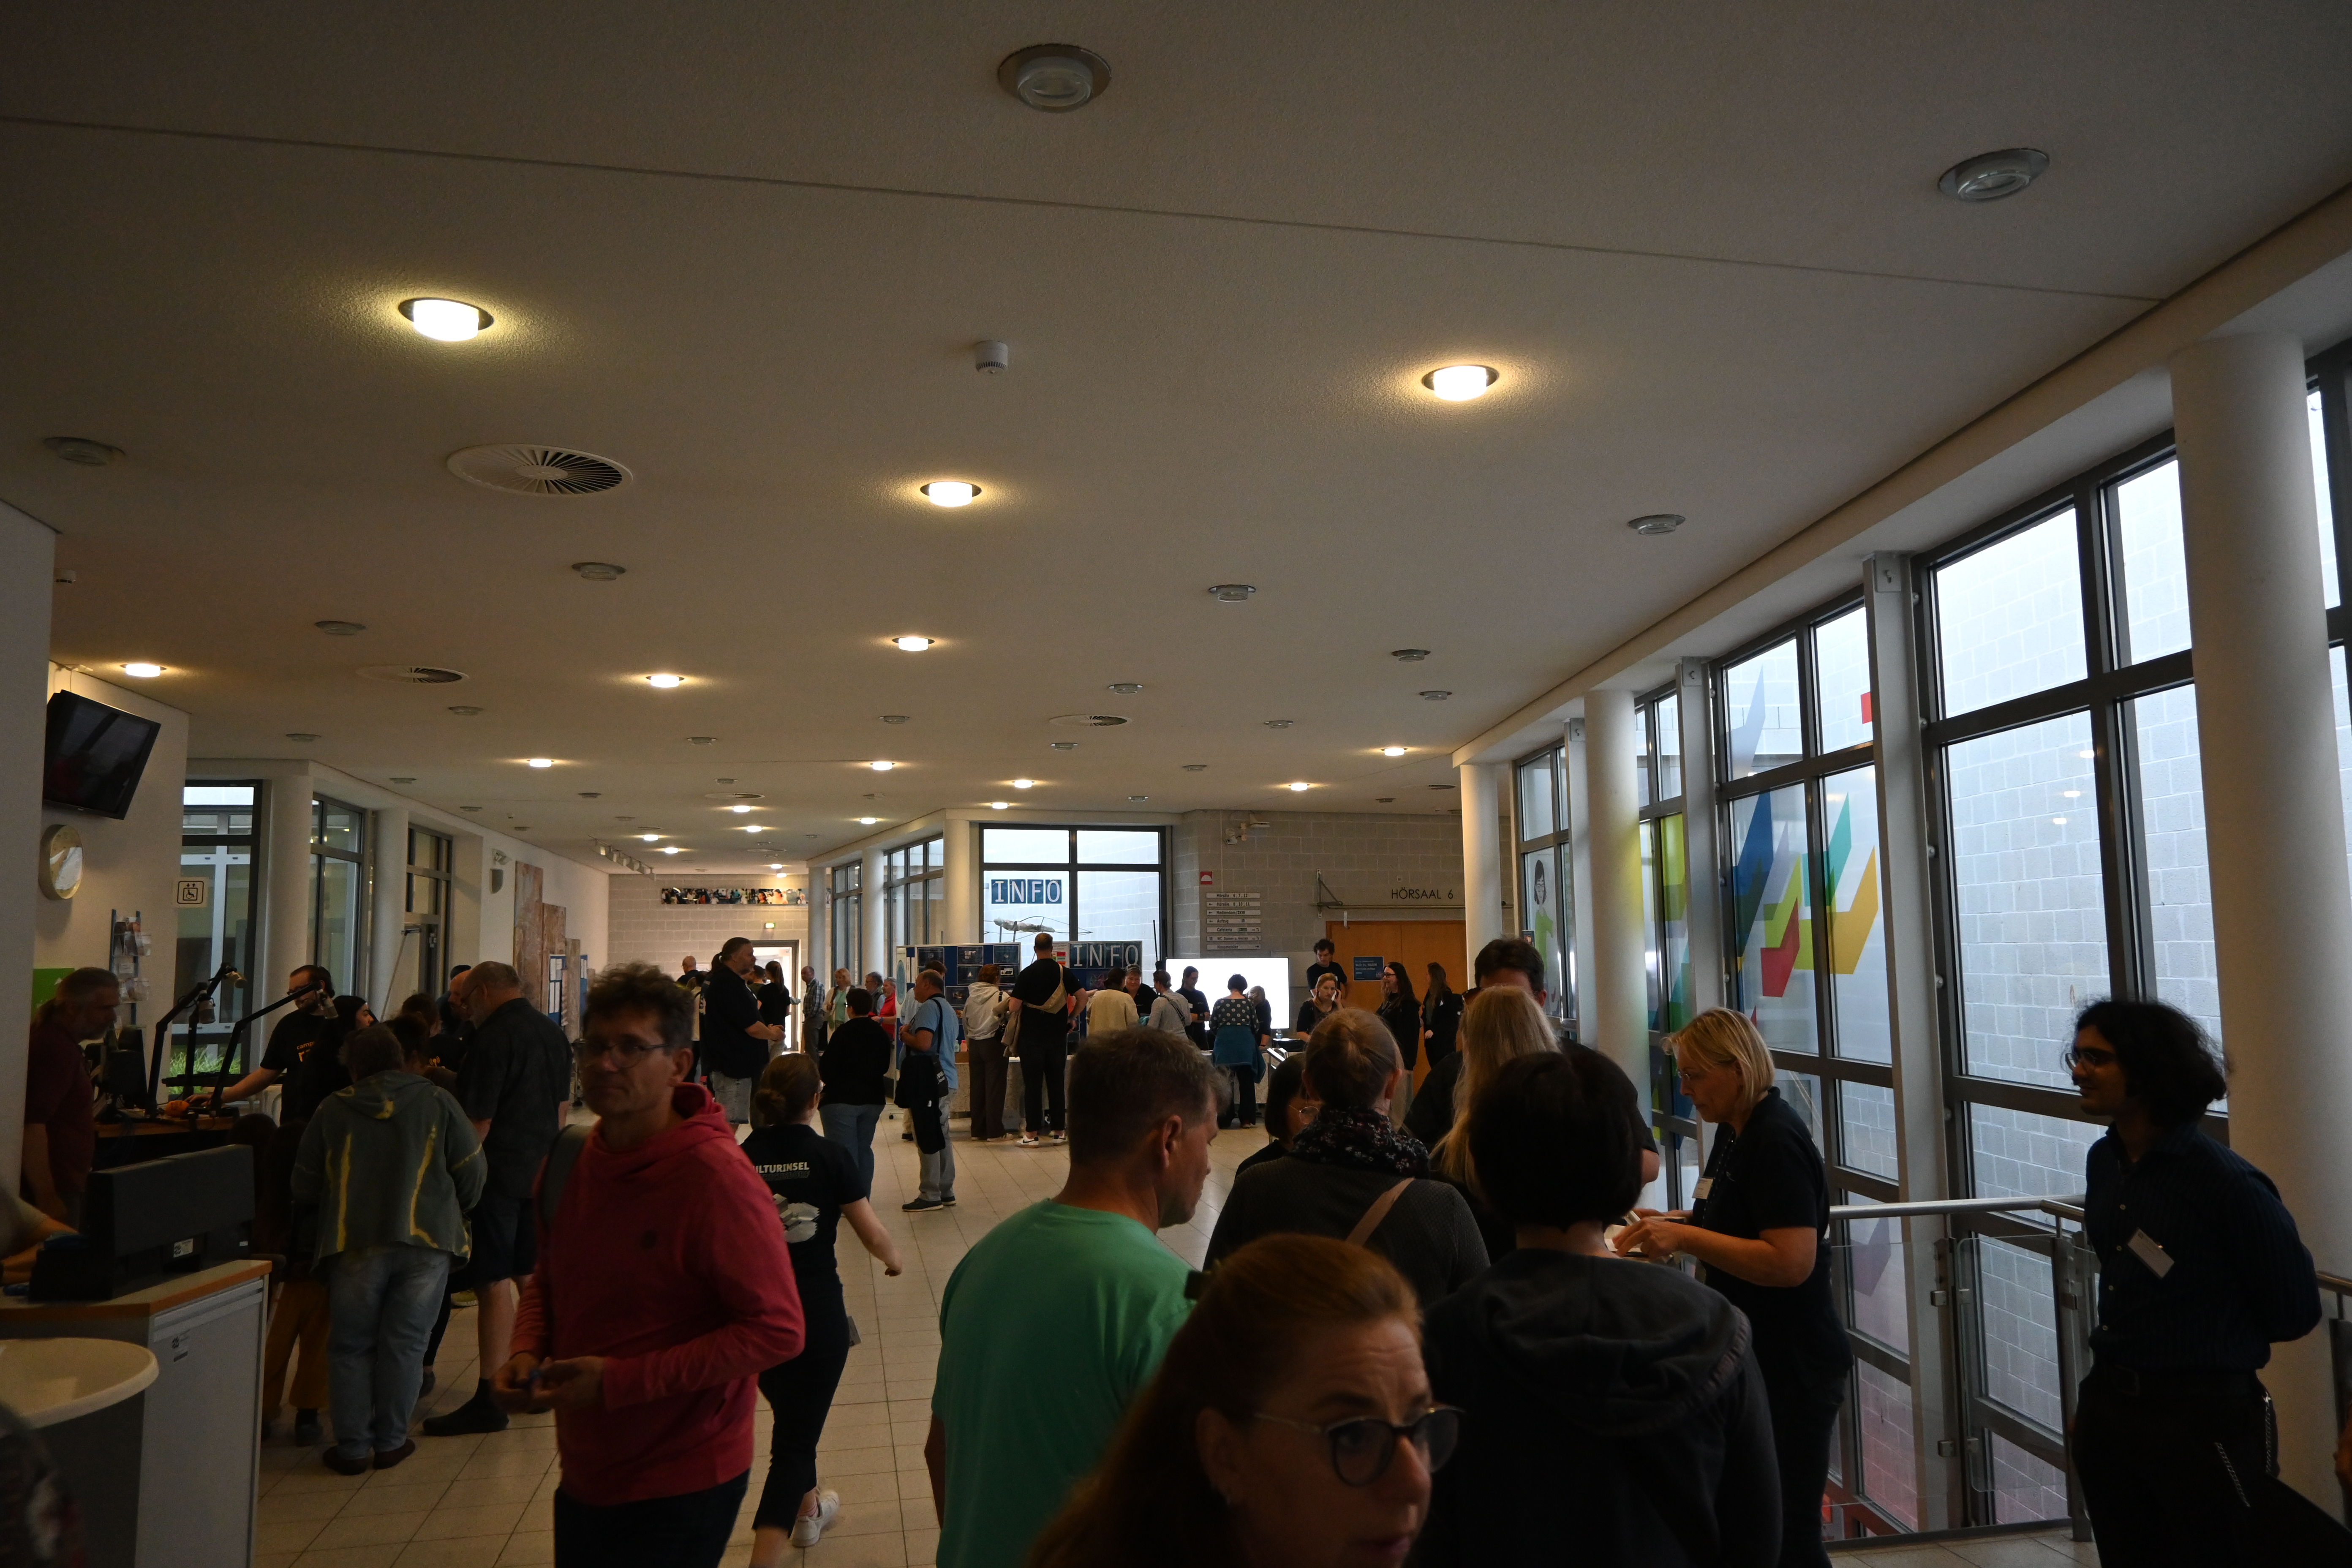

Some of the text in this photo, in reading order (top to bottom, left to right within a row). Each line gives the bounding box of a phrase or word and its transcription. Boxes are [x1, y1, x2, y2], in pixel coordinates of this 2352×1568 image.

[995, 880, 1060, 903] INFO
[1391, 887, 1454, 899] HÖRSAAL 6
[1073, 944, 1139, 967] INFO
[754, 1162, 810, 1173] ULTURINSEL
